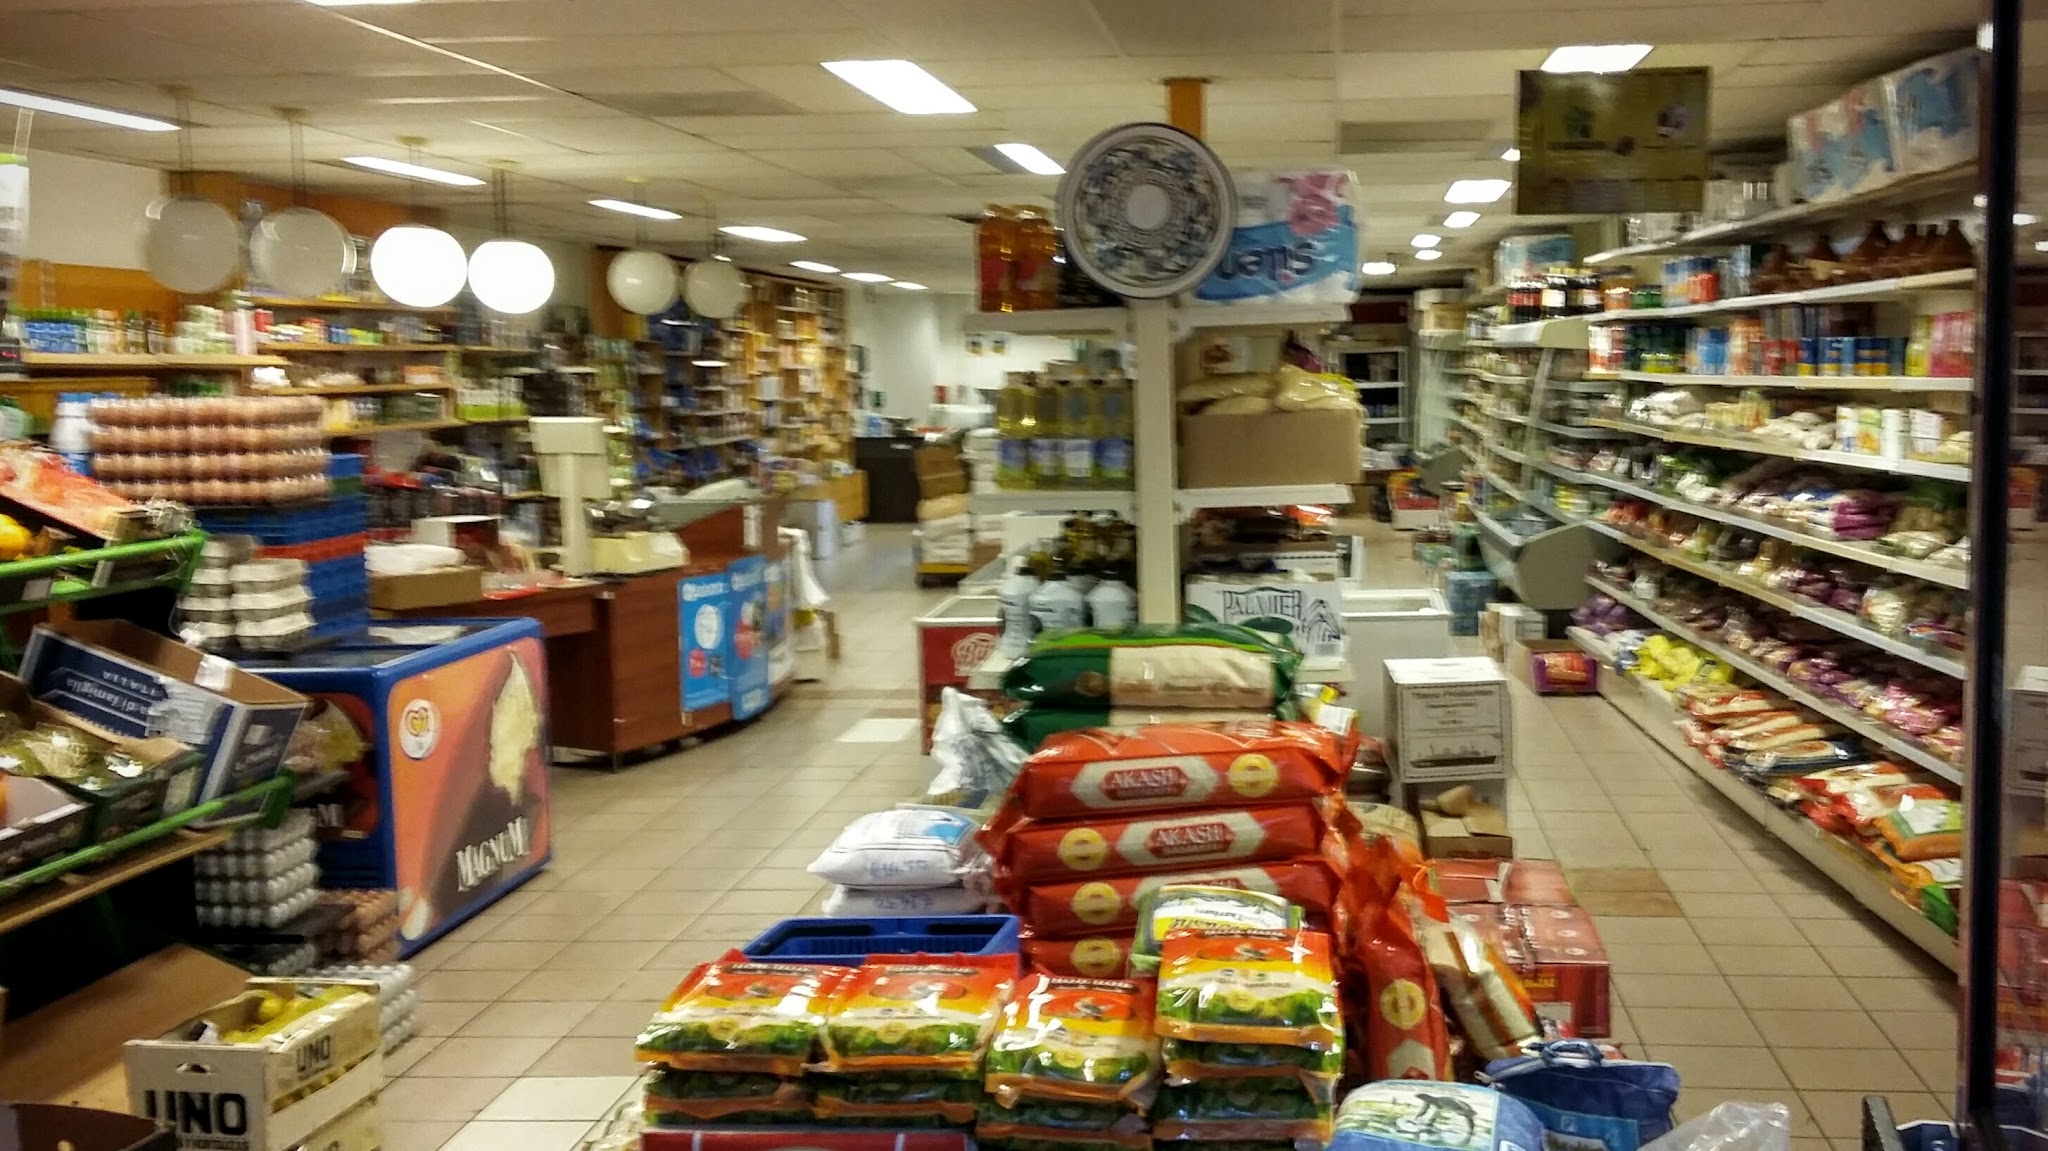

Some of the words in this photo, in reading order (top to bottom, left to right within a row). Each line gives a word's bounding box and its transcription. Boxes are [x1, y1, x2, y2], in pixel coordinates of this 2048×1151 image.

[1222, 589, 1302, 625] PALMIER
[1112, 767, 1178, 788] AKASH
[456, 815, 531, 892] MAGNUM
[1155, 824, 1225, 847] AKASH
[296, 1034, 331, 1072] UNO
[145, 1089, 248, 1135] UNO
